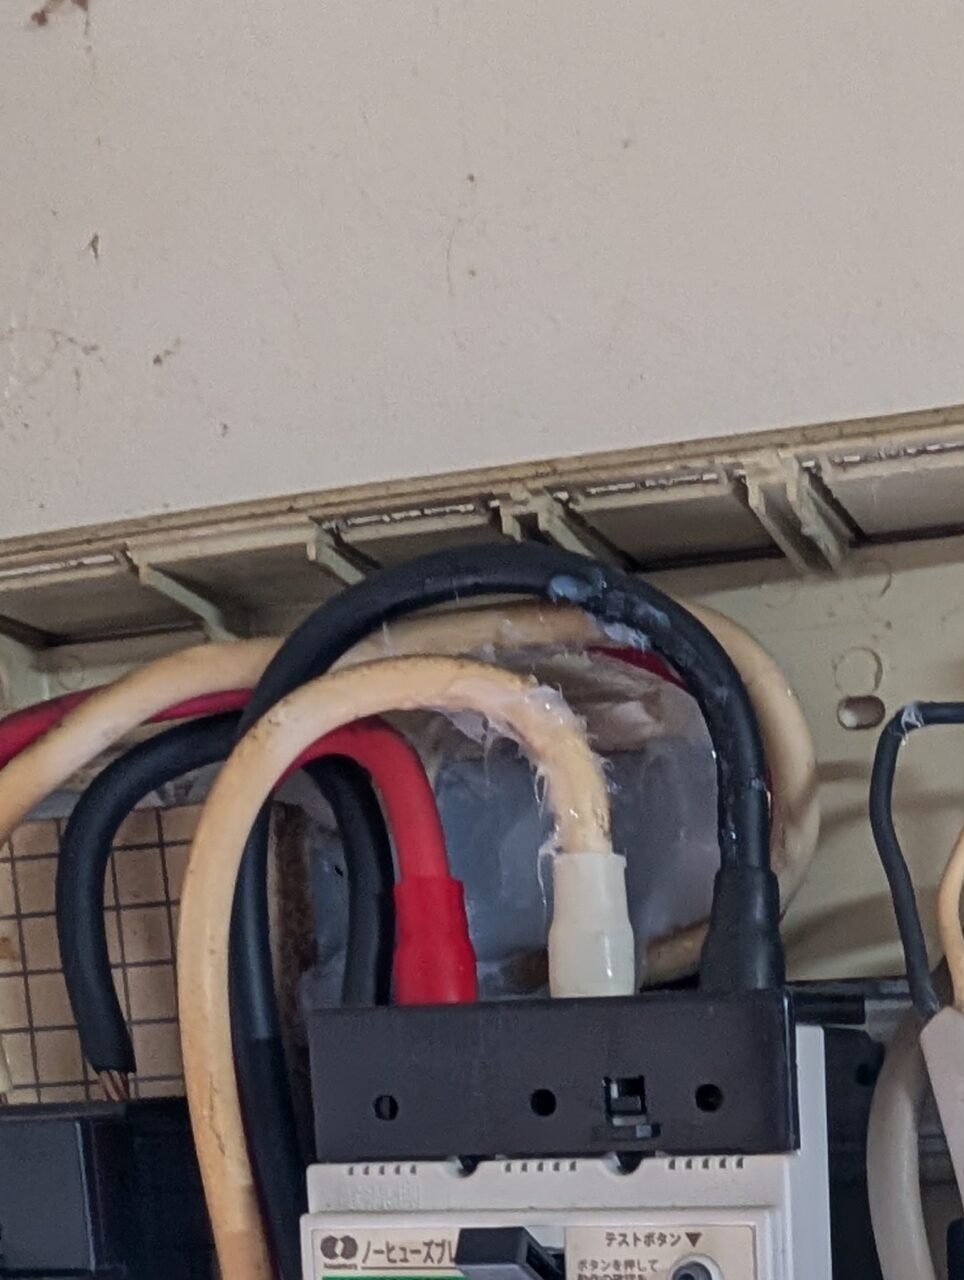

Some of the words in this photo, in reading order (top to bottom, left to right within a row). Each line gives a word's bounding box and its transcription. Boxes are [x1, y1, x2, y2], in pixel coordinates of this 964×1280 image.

[605, 1231, 682, 1248] テストボタン
[577, 1259, 660, 1273] ボタンを押して
